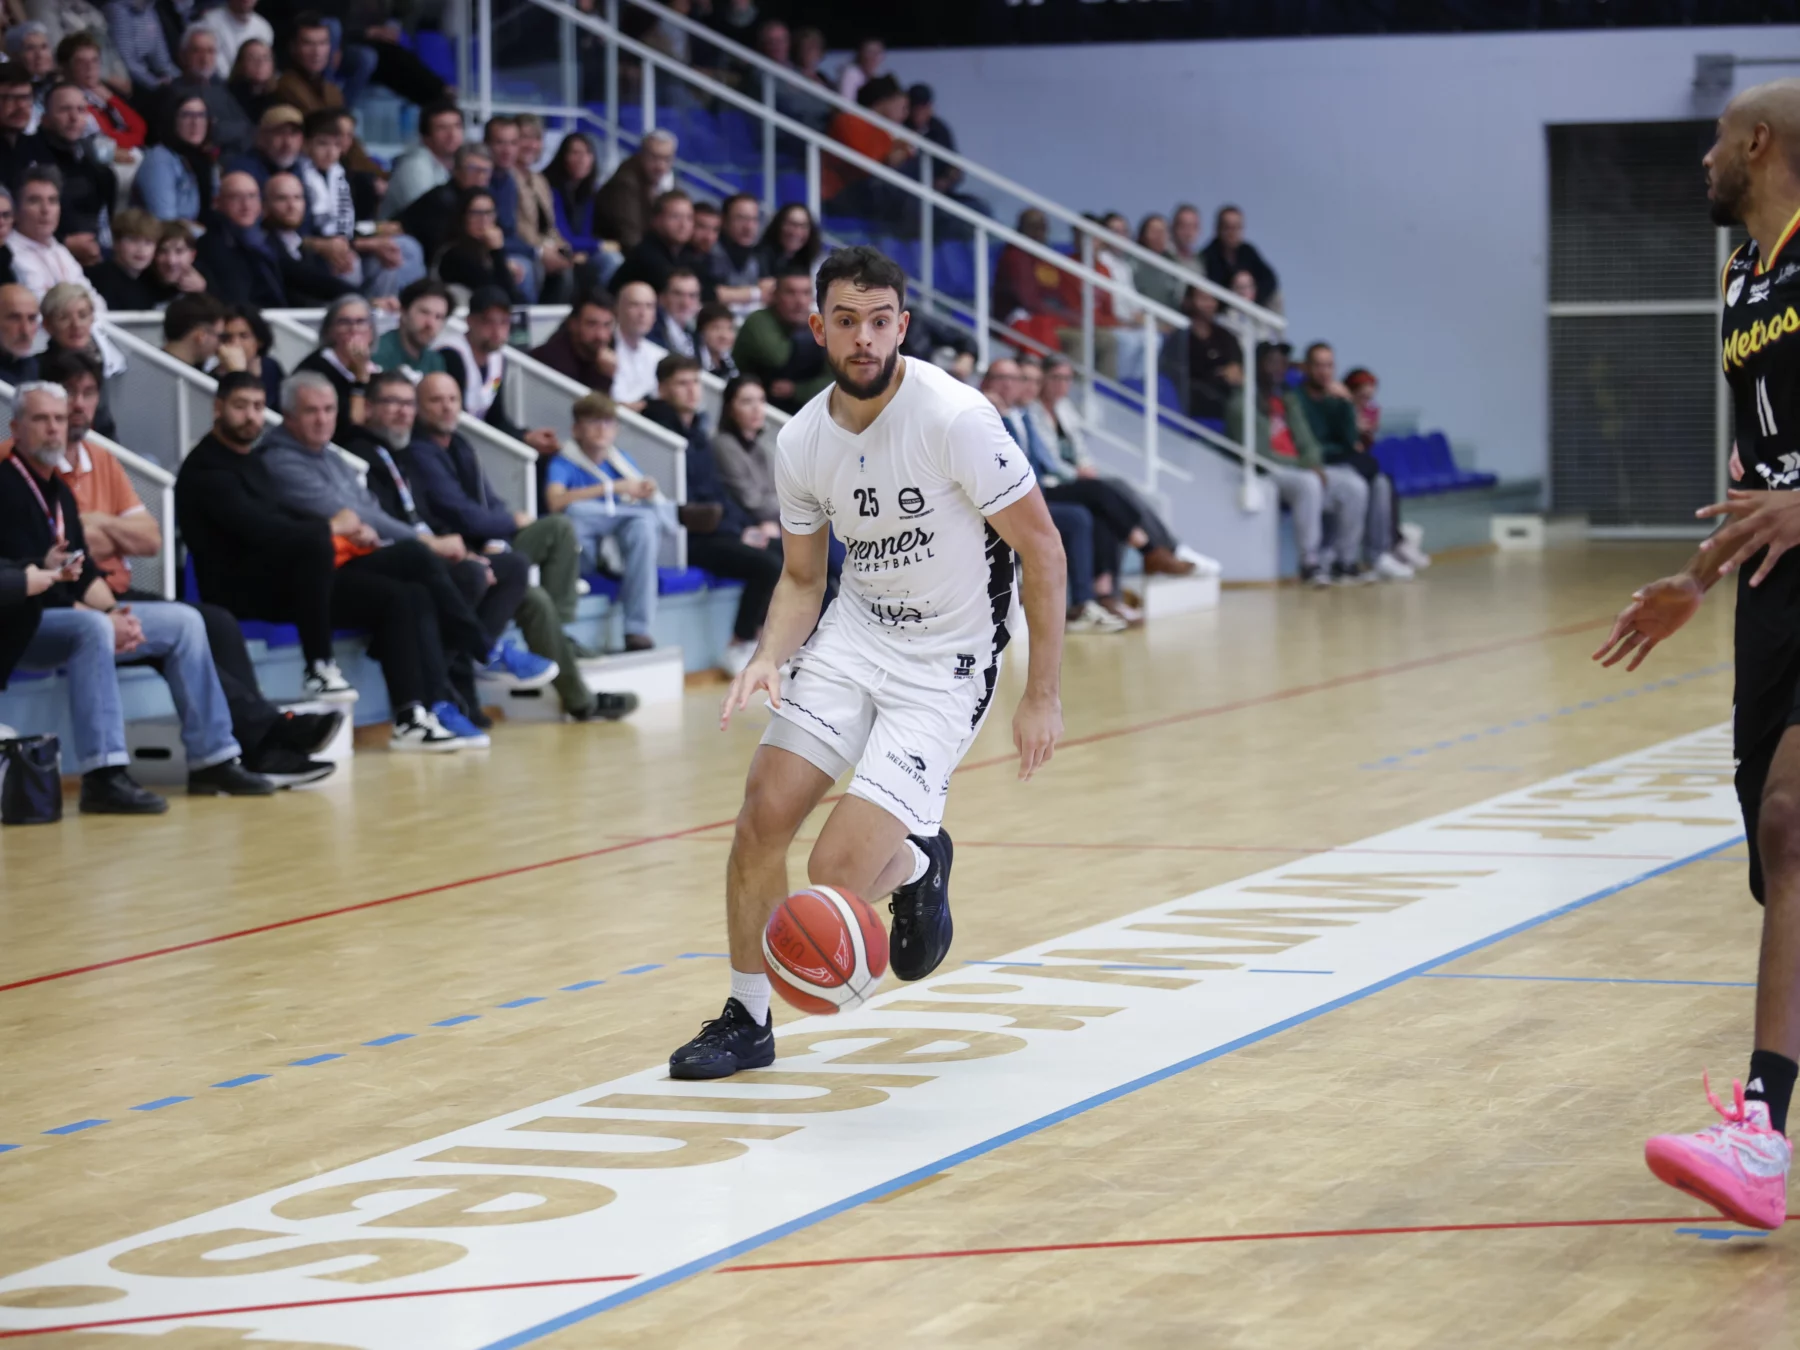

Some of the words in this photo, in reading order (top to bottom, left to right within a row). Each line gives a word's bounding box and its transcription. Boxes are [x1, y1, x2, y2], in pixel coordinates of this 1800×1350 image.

[1723, 305, 1800, 372] Metros
[1755, 375, 1778, 437] 11
[854, 487, 880, 517] 25
[844, 527, 935, 560] Rennes
